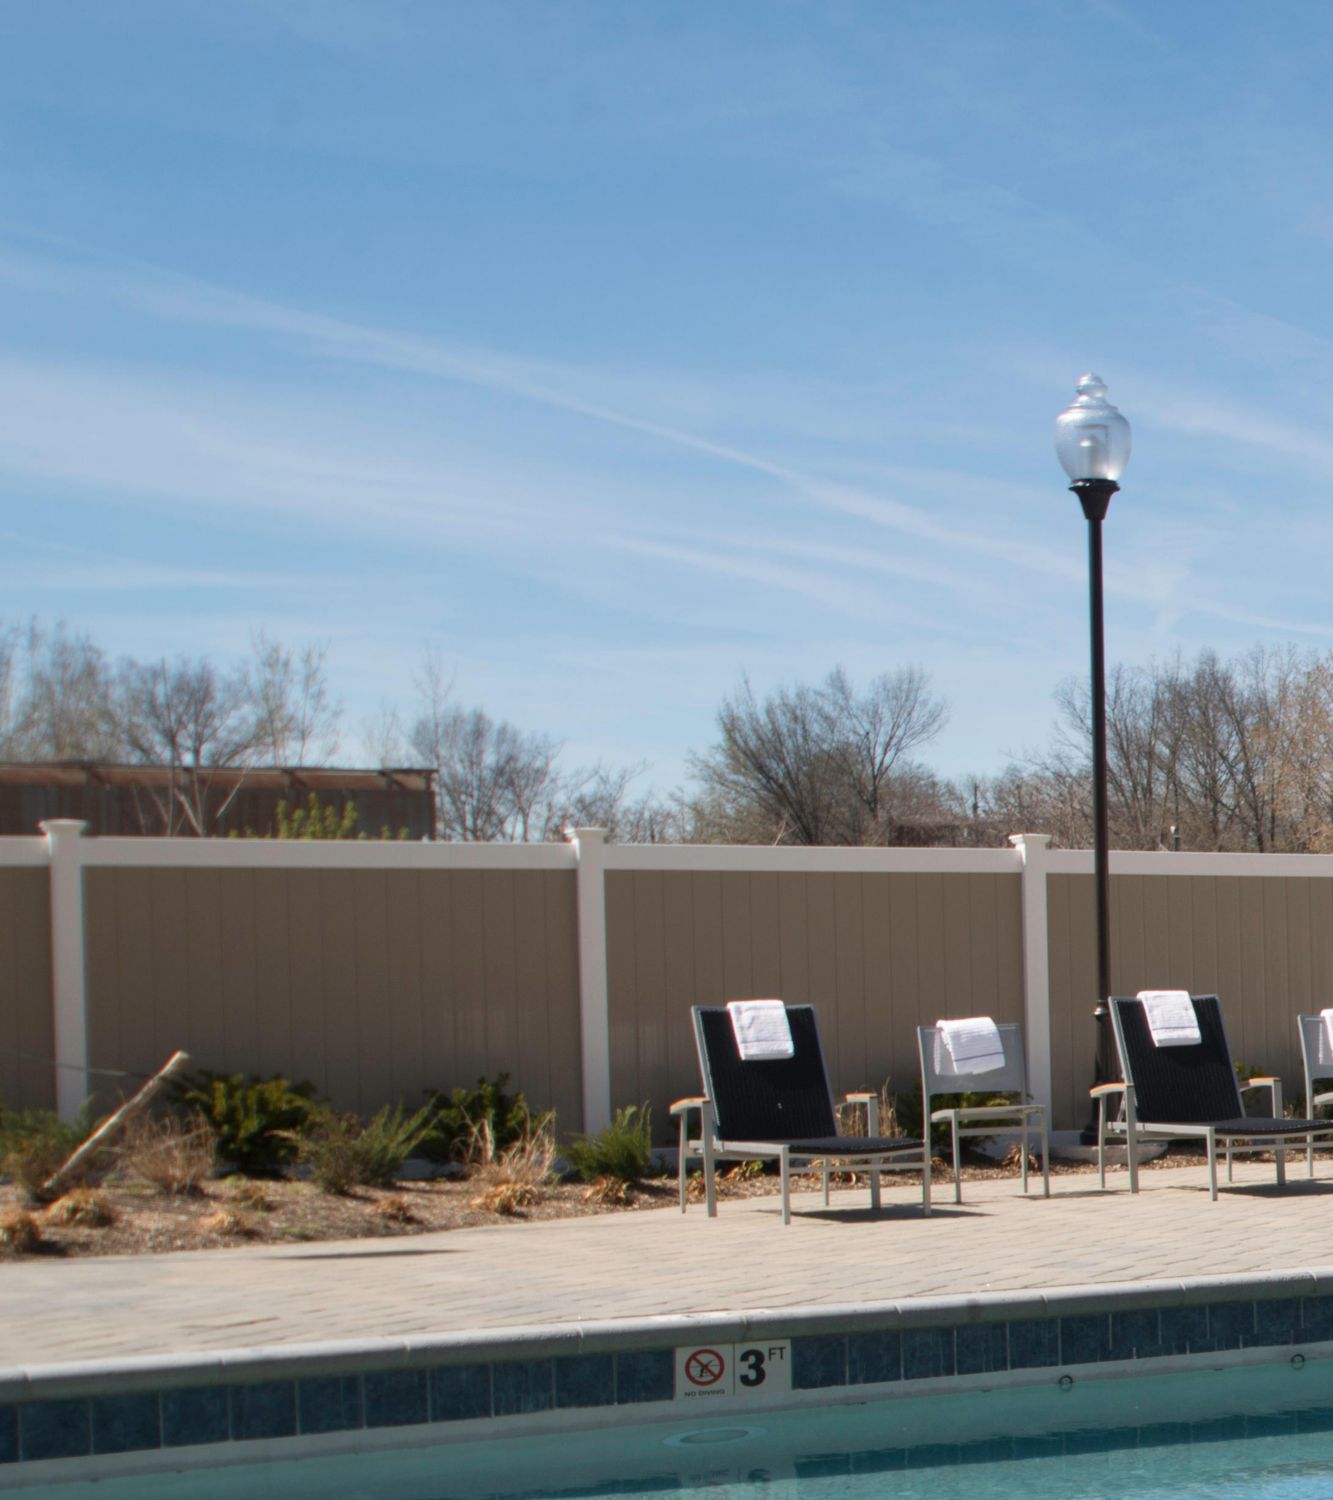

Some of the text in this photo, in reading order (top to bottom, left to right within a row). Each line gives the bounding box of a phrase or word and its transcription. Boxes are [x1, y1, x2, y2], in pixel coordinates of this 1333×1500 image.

[739, 1346, 787, 1387] 3 FT
[698, 1388, 725, 1396] DIVING
